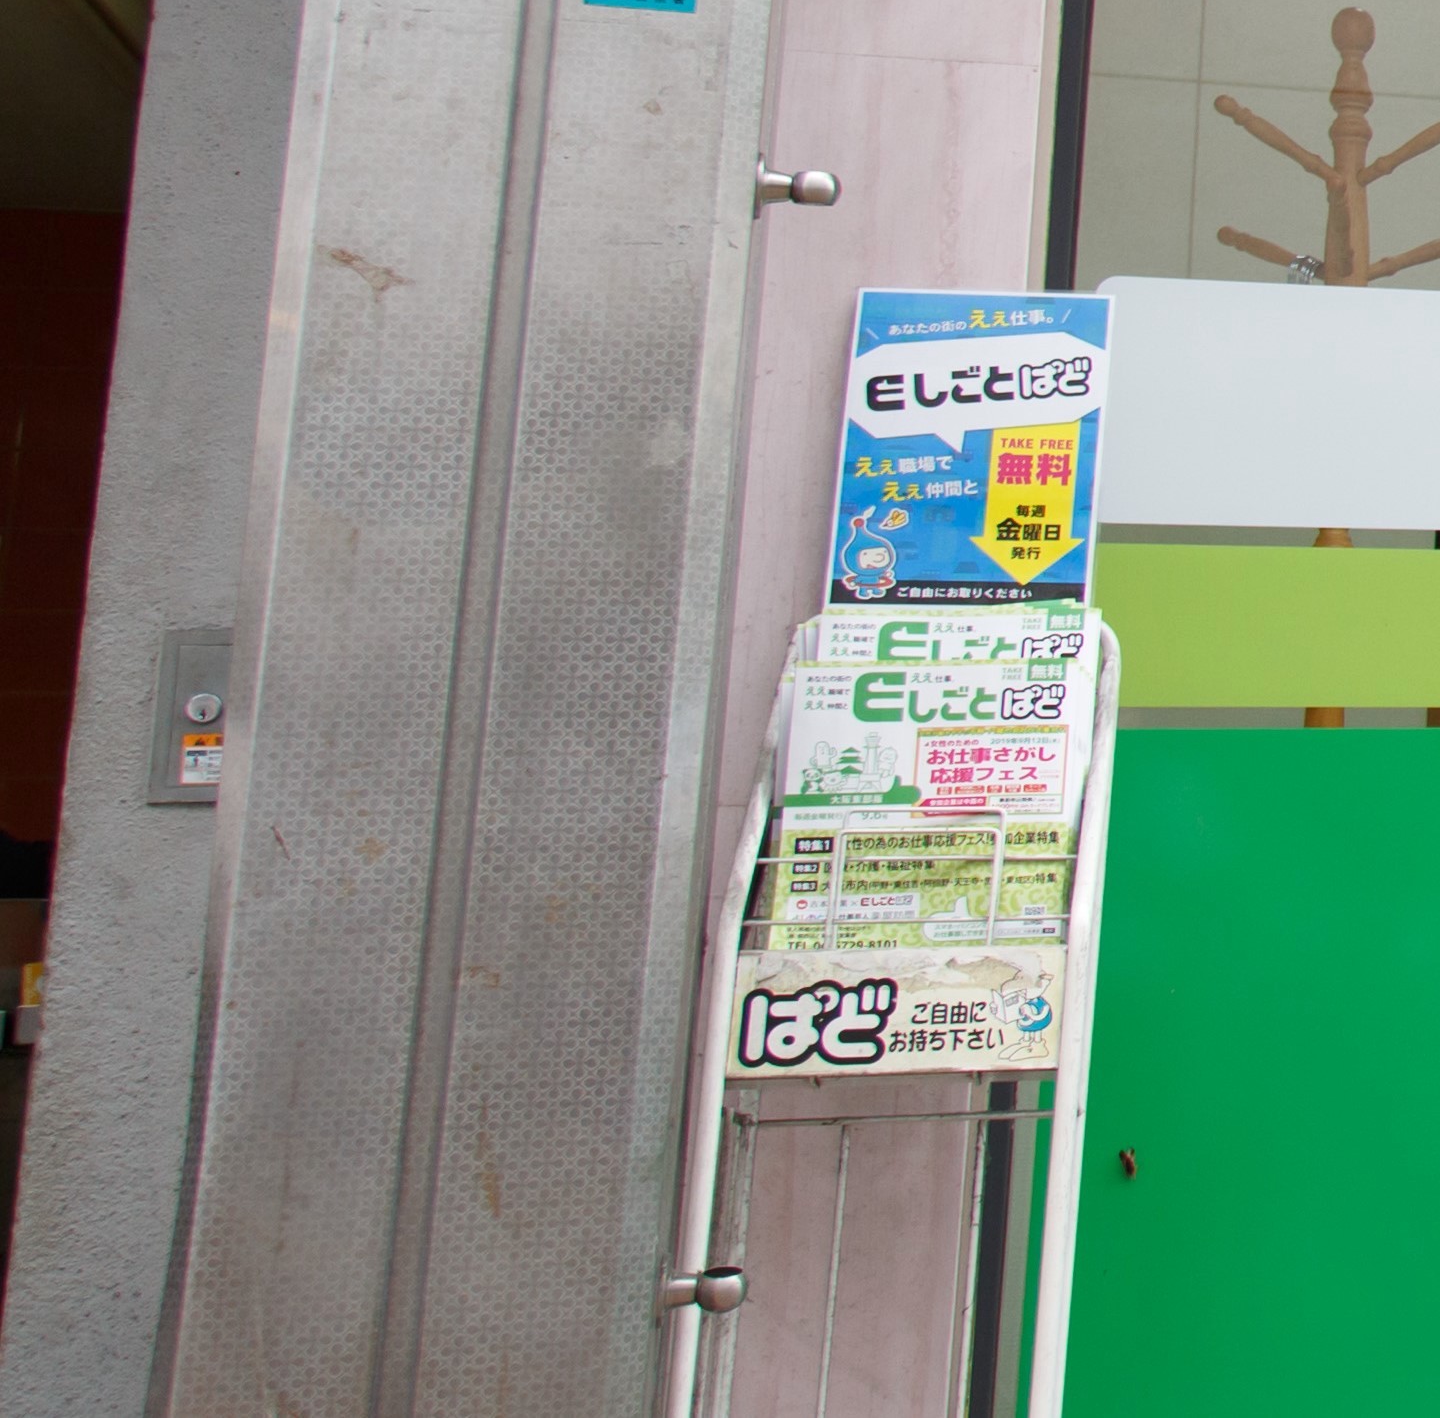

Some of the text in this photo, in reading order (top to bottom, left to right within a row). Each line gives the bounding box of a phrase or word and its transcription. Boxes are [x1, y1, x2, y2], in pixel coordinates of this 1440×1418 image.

[1000, 438, 1074, 451] TAKE FREE
[996, 452, 1073, 486] 無料
[1016, 504, 1047, 518] 毎週
[996, 517, 1062, 542] 金曜日
[1010, 546, 1042, 560] 発行
[896, 586, 1033, 599] ご自由にお取りください
[1050, 614, 1082, 629] 無料
[1030, 665, 1063, 681] 無料
[926, 746, 1057, 765] お仕事さがし
[929, 766, 1039, 784] 応援フェス
[798, 839, 831, 852] 特集1
[910, 1000, 988, 1025] ご自由に
[737, 977, 899, 1068] ぱど
[888, 1027, 1005, 1054] お持ち下さい
